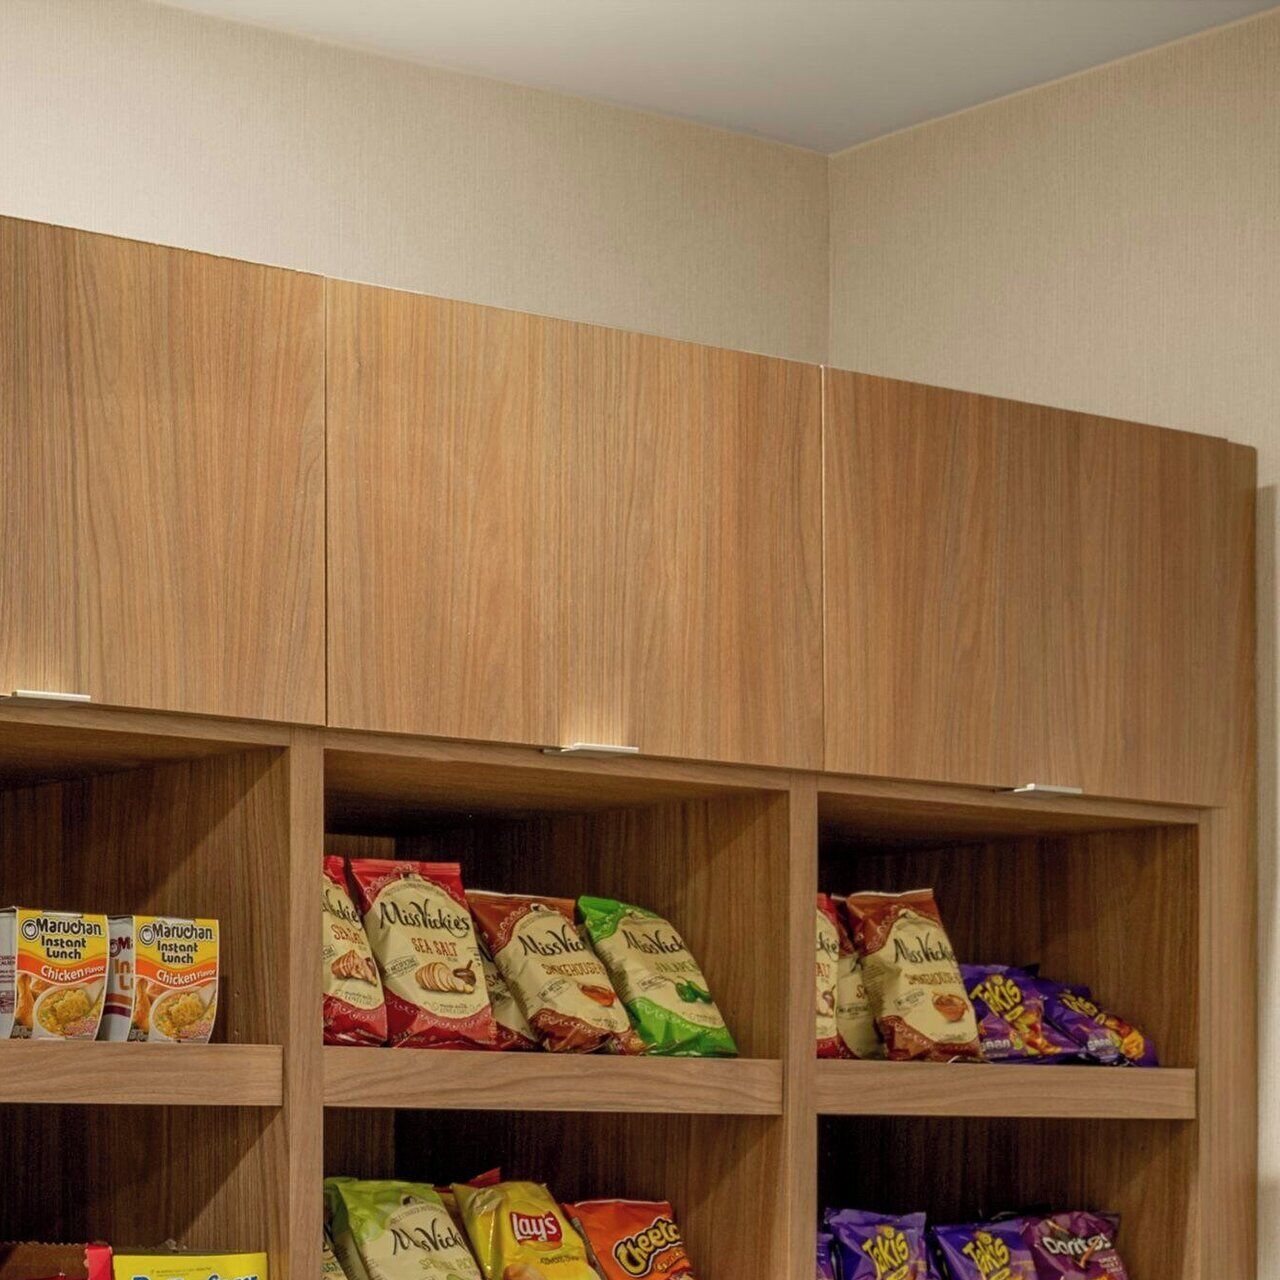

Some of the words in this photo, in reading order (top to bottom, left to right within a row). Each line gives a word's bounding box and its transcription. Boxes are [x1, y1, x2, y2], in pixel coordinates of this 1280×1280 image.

[37, 919, 101, 936] Maruchan
[153, 923, 212, 939] Maruchan
[41, 936, 86, 948] Instant
[157, 941, 198, 952] Instant
[412, 938, 432, 955] SEA
[435, 942, 457, 957] SALT
[46, 948, 81, 959] Lunch
[161, 953, 193, 963] Lunch
[41, 965, 84, 980] Chicken
[84, 966, 105, 974] Flavor
[156, 969, 196, 984] Chicken
[197, 969, 216, 978] Flavor
[970, 974, 1022, 1017] Takis
[512, 1214, 560, 1240] Lay's
[1045, 1232, 1112, 1257] Doritos
